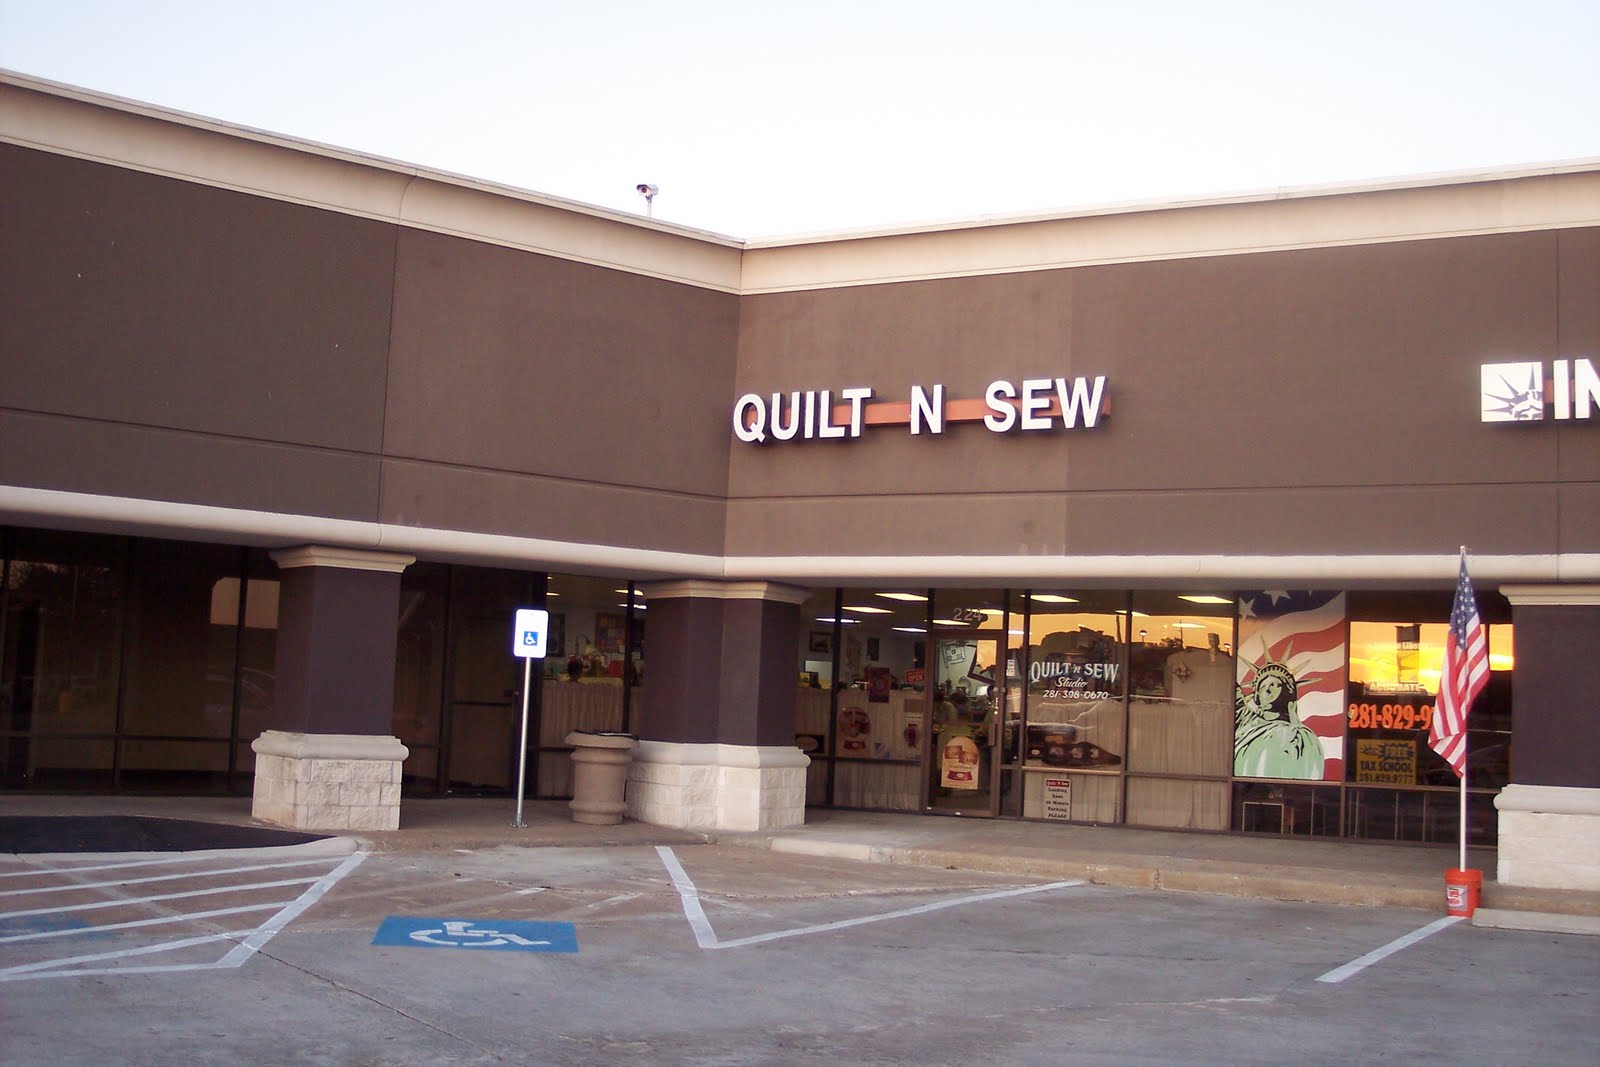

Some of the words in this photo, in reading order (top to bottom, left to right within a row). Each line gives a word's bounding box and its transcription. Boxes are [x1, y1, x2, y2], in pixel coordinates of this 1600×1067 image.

[733, 387, 874, 444] QUILT
[910, 384, 945, 435] N
[984, 376, 1108, 433] SEW
[1031, 661, 1071, 684] QUILT
[1084, 663, 1120, 684] SEW
[1055, 676, 1089, 688] Studio
[1360, 760, 1376, 771] TAX
[1378, 761, 1413, 773] SCHOOL
